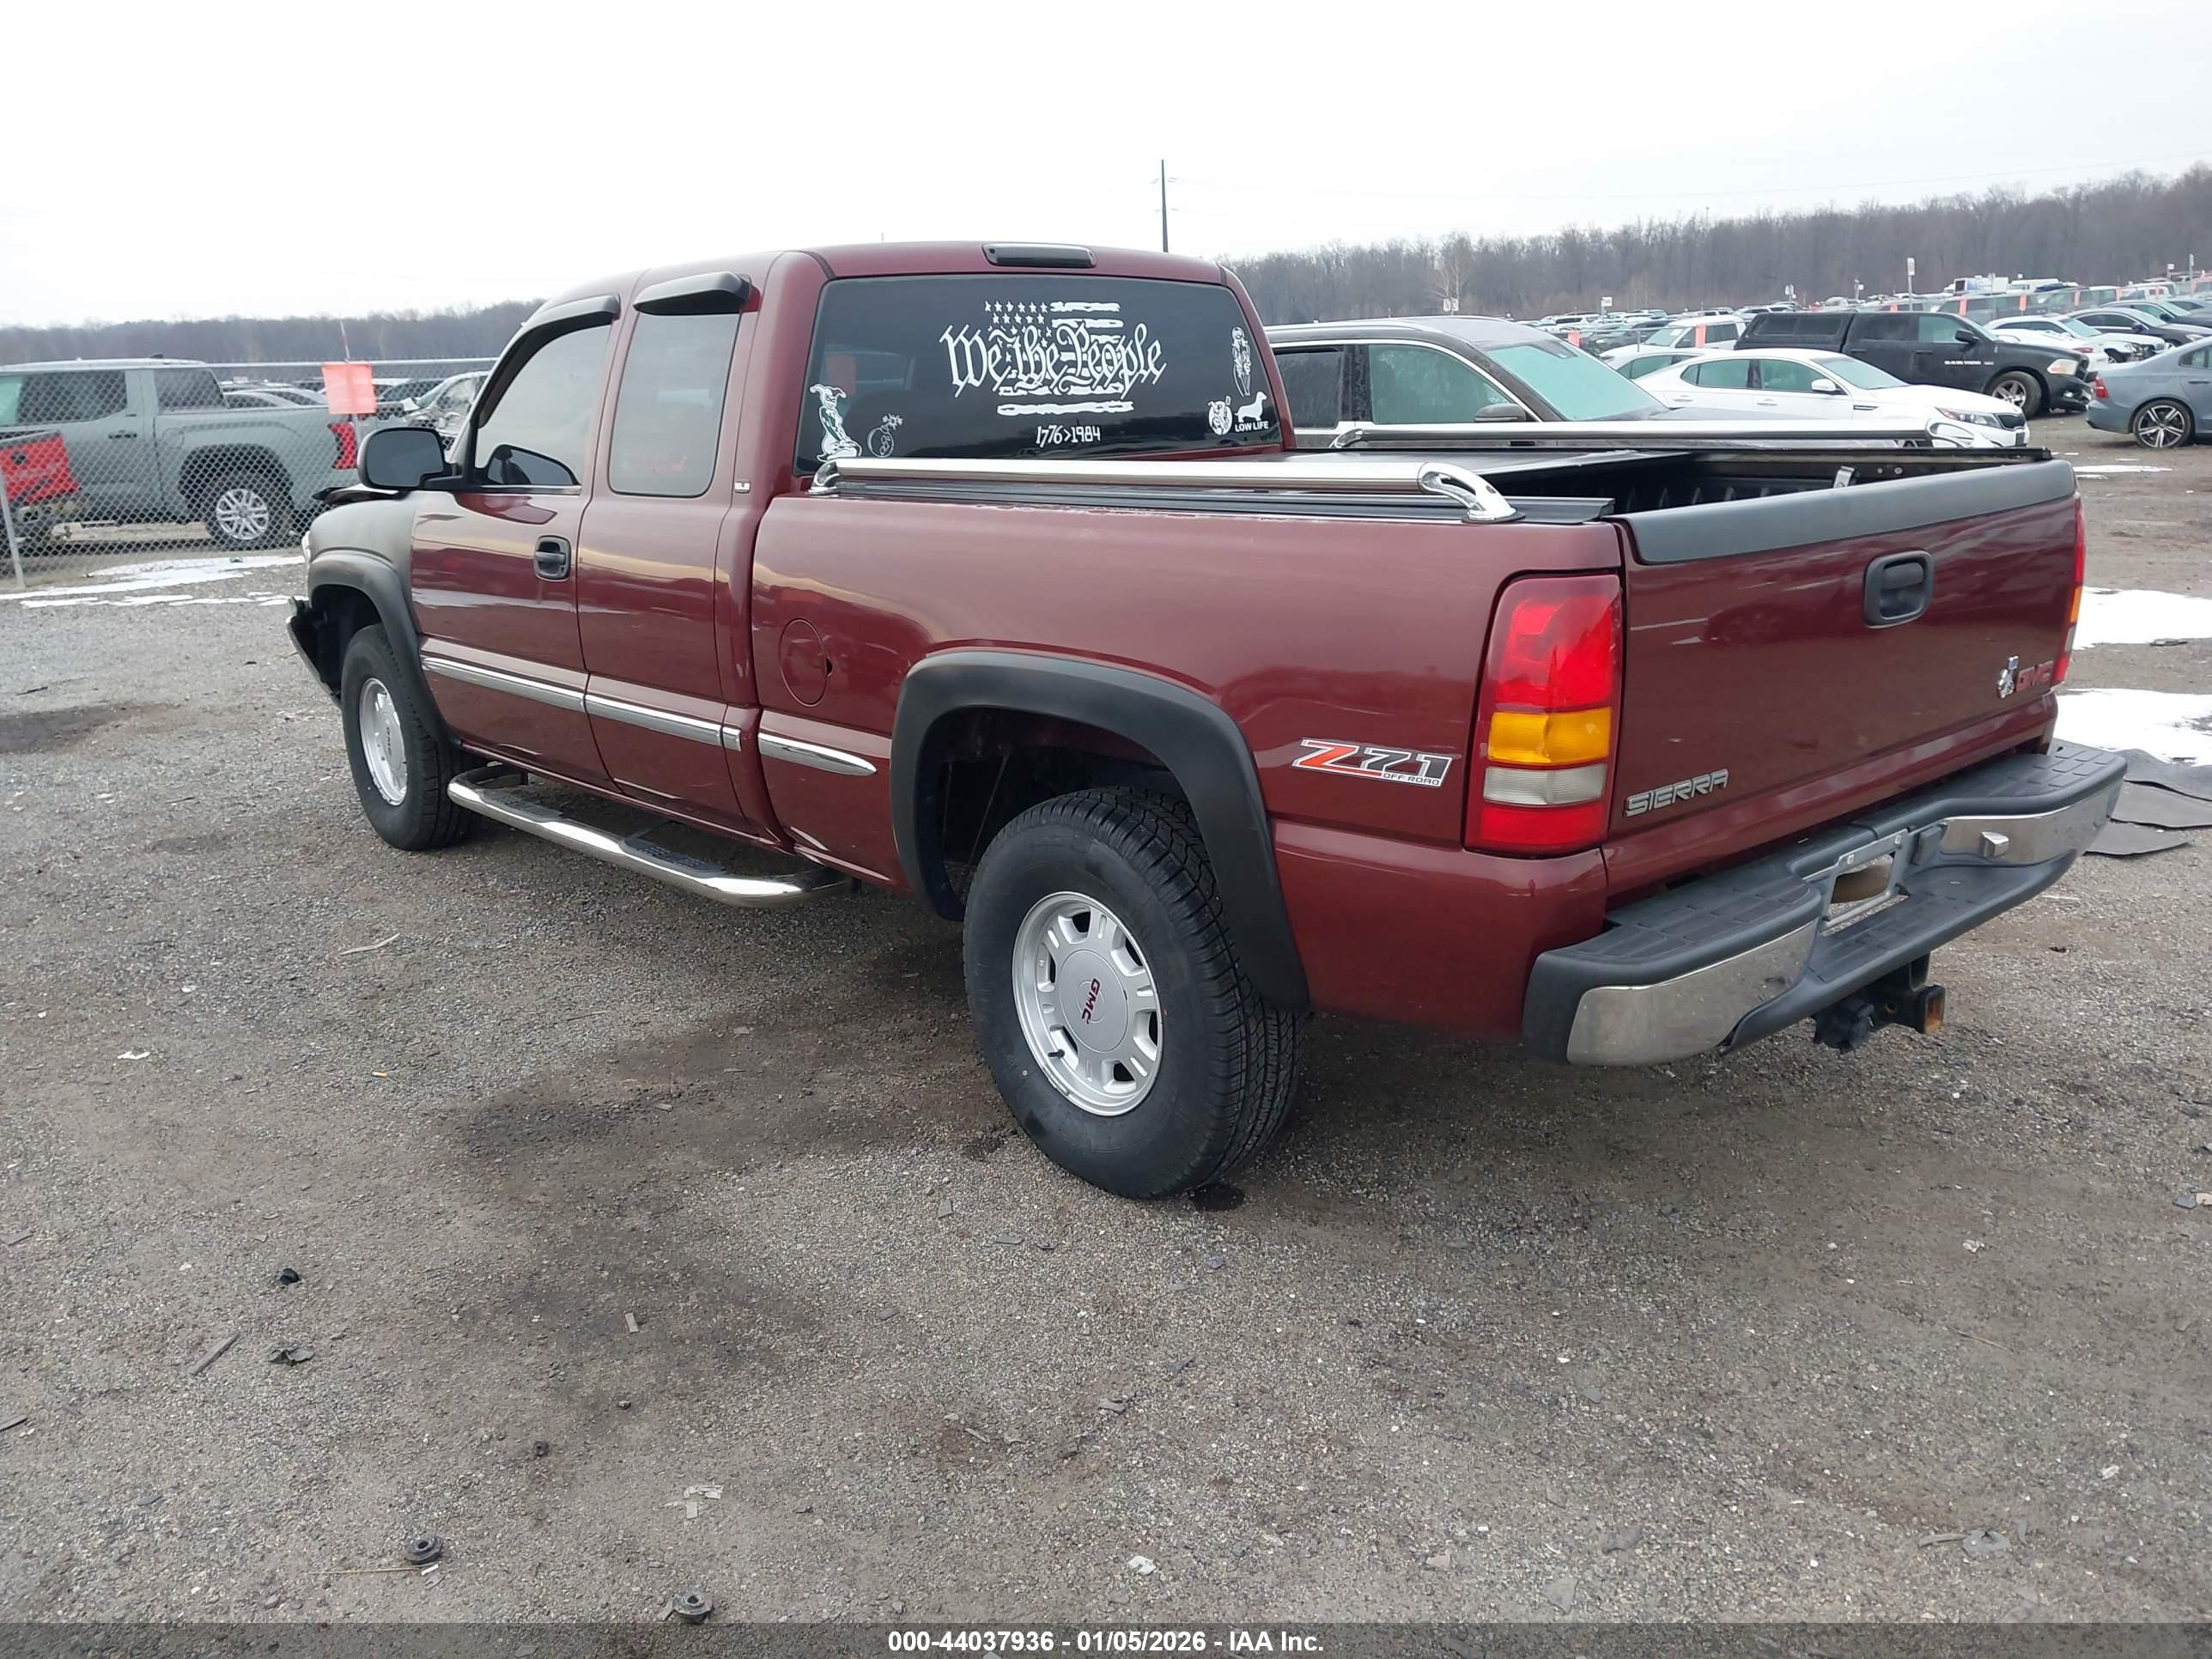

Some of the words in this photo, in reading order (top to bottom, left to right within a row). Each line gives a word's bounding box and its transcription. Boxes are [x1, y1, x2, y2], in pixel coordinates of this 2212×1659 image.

[939, 324, 1012, 398] We
[988, 325, 1068, 390] the
[1055, 323, 1167, 399] People
[1036, 424, 1101, 448] 1776>1984
[1235, 422, 1252, 432] LOW
[1253, 421, 1269, 430] LIFE
[2016, 659, 2054, 692] GMC
[1291, 738, 1453, 781] Z71
[1382, 773, 1405, 781] OFF
[1407, 775, 1440, 786] ROAD
[1625, 769, 1729, 817] SIERRA
[1081, 978, 1101, 1025] GMC
